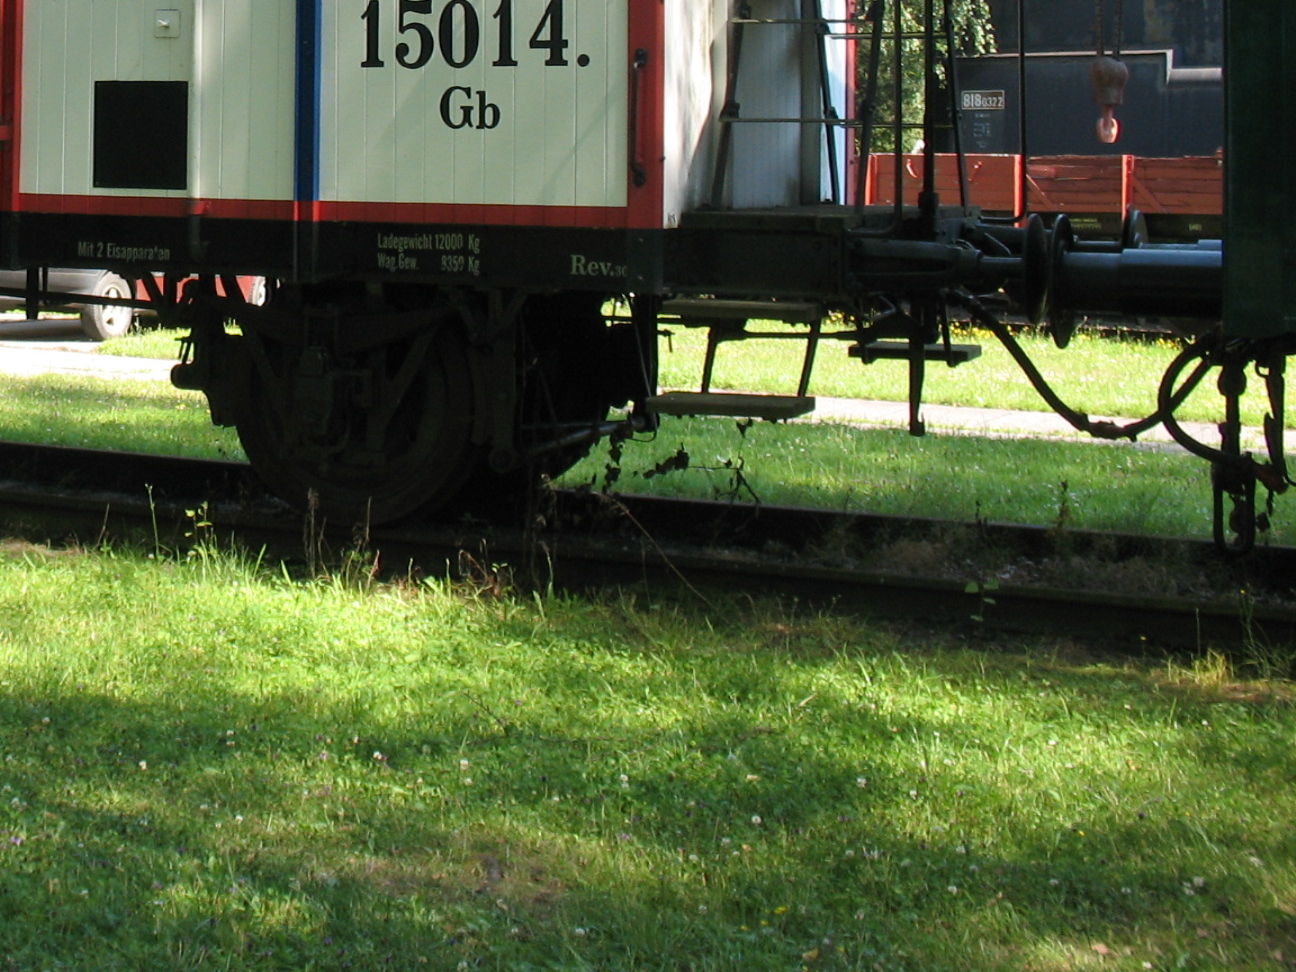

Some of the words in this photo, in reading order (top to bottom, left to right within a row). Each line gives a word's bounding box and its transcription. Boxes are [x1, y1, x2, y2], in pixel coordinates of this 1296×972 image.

[440, 86, 501, 129] Gb
[77, 241, 94, 258] Mit
[97, 241, 104, 258] 2
[377, 232, 433, 253] Ladegewicht
[434, 233, 464, 250] 12000
